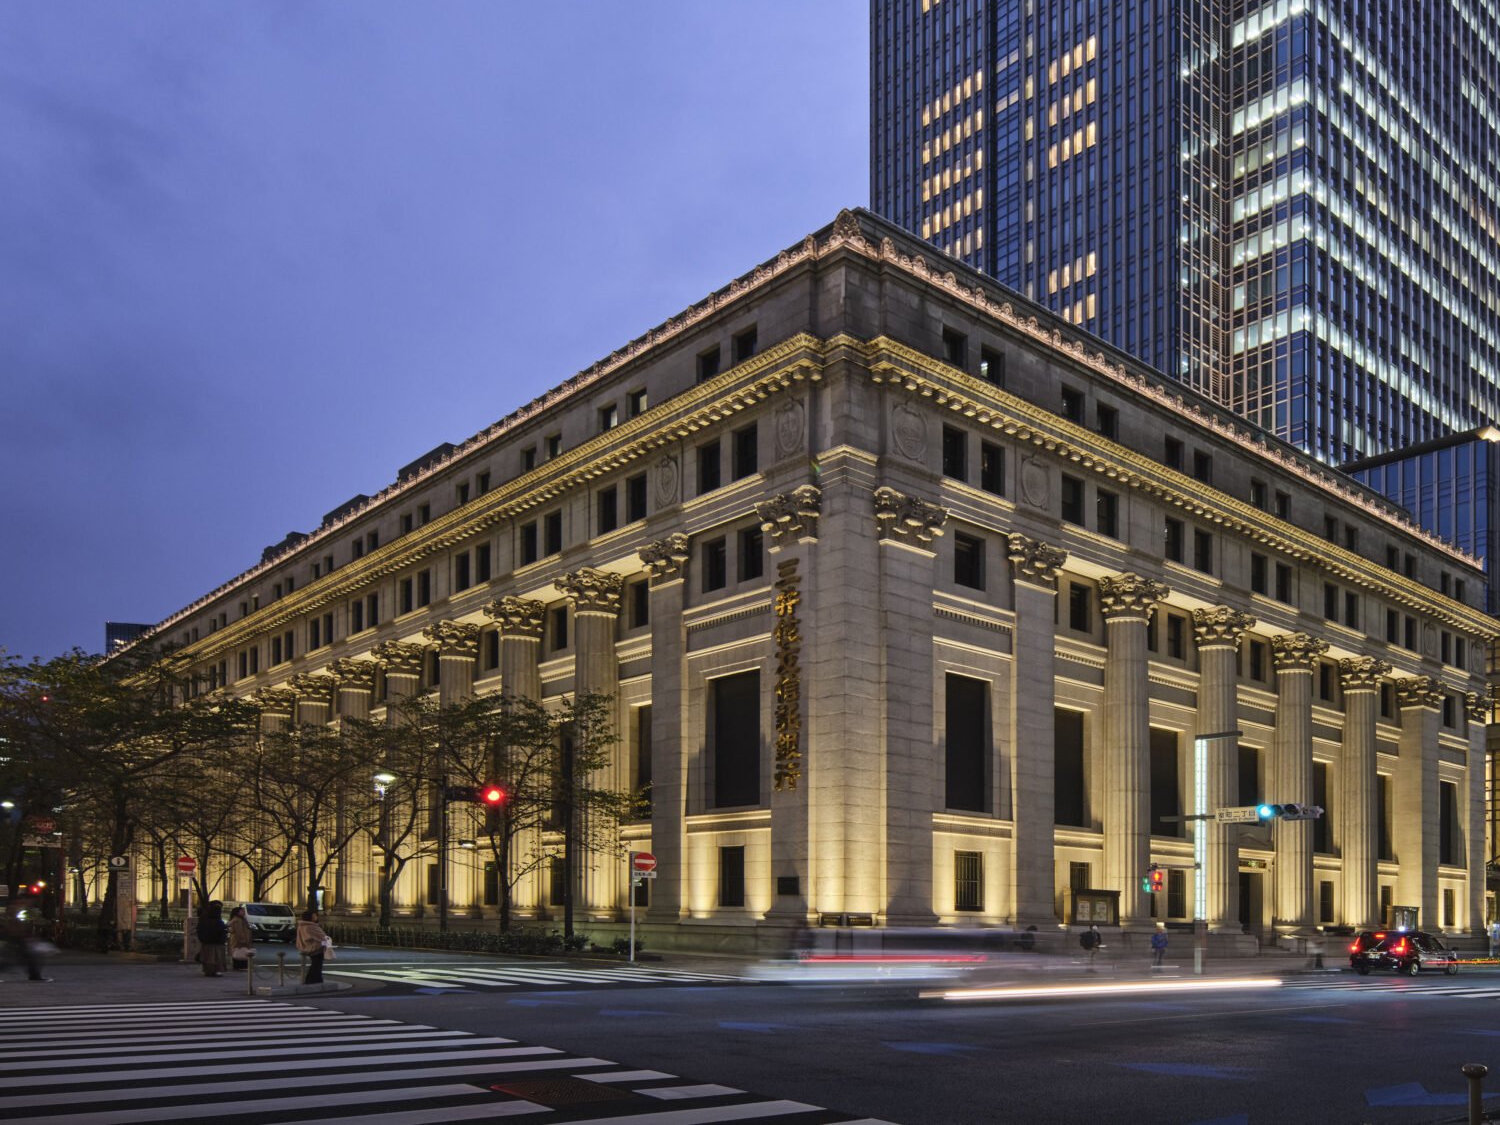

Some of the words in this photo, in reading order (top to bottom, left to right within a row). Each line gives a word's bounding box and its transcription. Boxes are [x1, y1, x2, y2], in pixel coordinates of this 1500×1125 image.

[774, 557, 802, 791] 三井住友信託銀行
